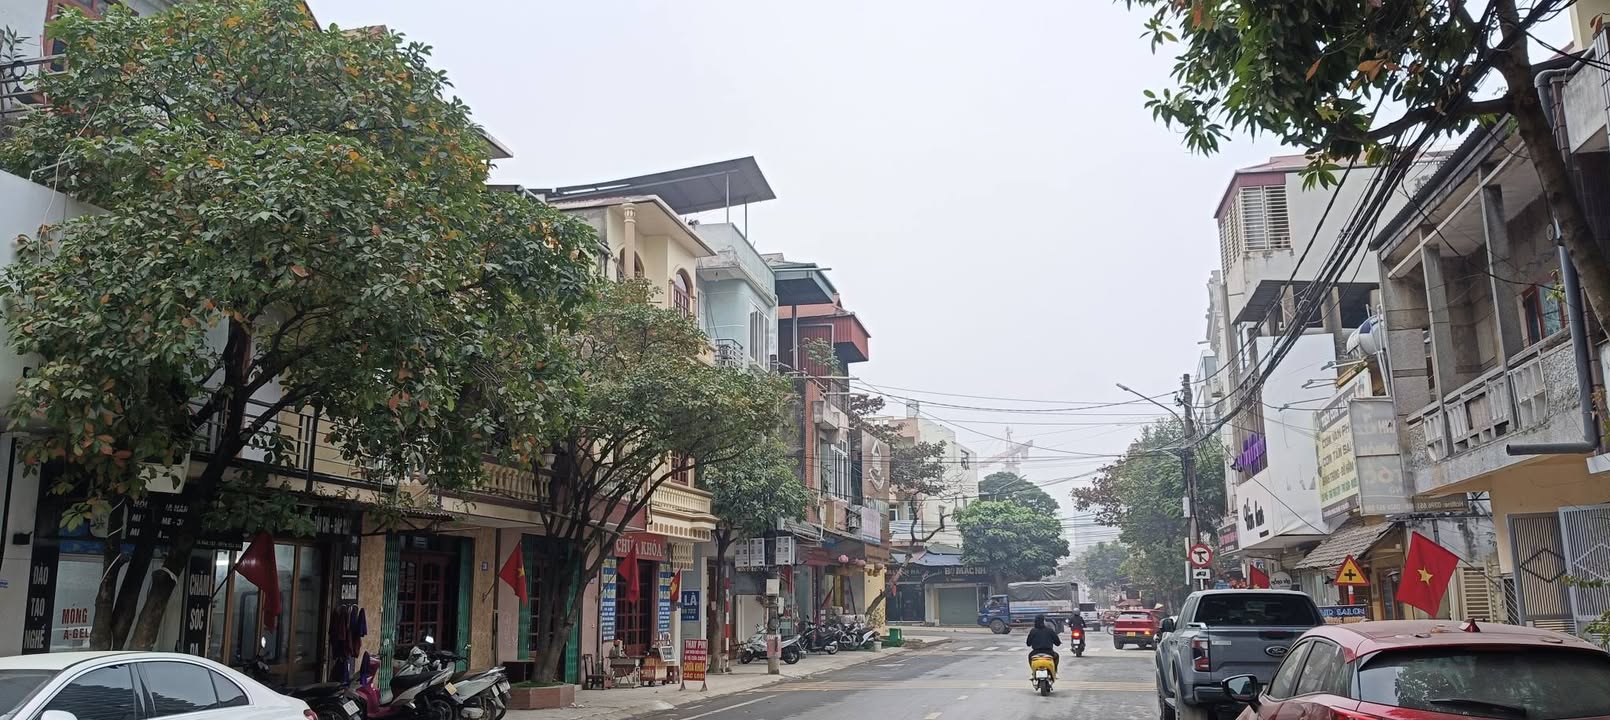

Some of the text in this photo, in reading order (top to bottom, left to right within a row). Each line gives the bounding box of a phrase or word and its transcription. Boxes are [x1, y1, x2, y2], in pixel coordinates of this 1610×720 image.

[640, 538, 663, 557] KHÓA
[31, 597, 45, 621] TẠO
[189, 603, 205, 630] SÓC
[1336, 607, 1365, 615] SALON
